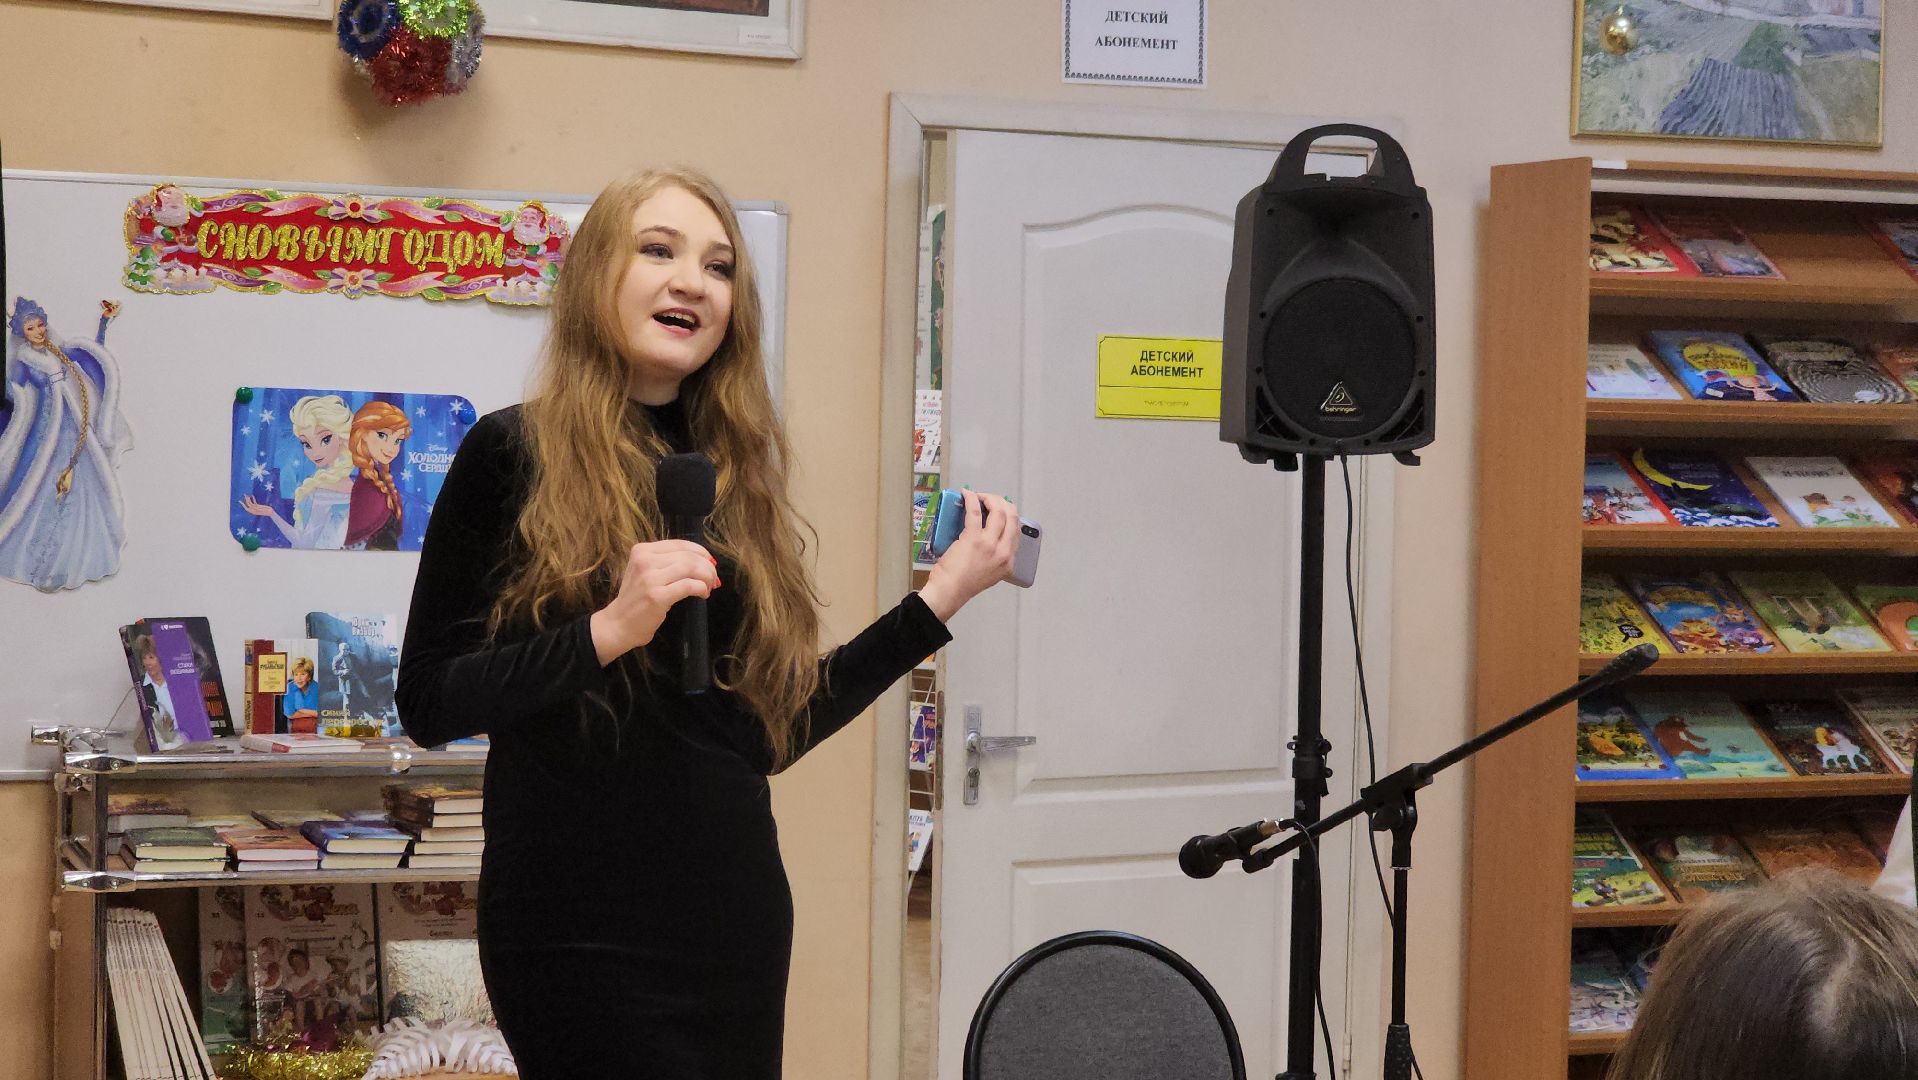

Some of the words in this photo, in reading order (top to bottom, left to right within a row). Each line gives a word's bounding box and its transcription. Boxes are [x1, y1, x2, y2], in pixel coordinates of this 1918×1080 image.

[1105, 11, 1168, 24] ДЕТСКИЙ
[1095, 36, 1178, 49] АБОНЕМЕНТ
[1139, 349, 1194, 363] ДЕТСКИЙ
[1130, 365, 1204, 378] АБОНЕМЕНТ
[1325, 405, 1357, 414] behringer
